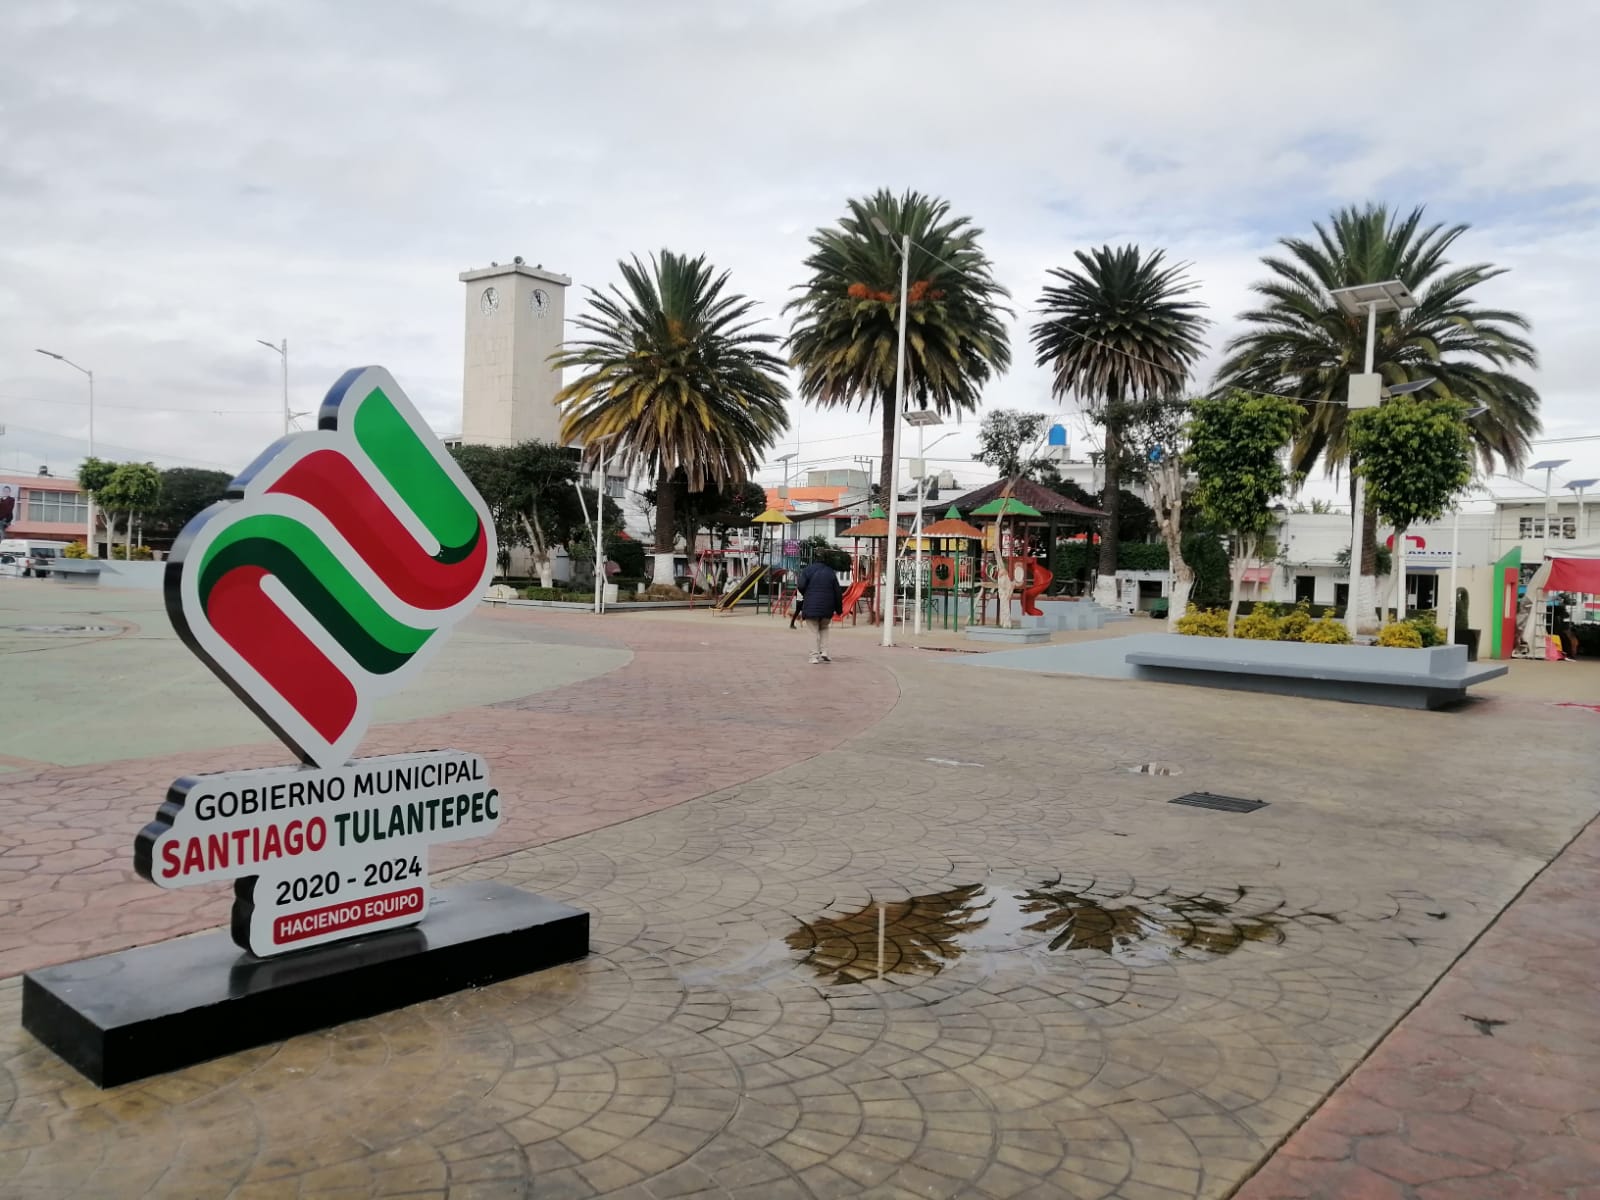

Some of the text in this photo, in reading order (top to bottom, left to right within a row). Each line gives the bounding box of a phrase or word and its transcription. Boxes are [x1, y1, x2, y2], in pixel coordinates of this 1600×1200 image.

[195, 759, 484, 821] GOBIERNO MUNICIPAL
[162, 788, 499, 878] SANTIAGO TULANTEPEC
[276, 871, 340, 906] 2020
[364, 856, 423, 887] 2024
[280, 893, 419, 938] HACIENDO EQUIPO
